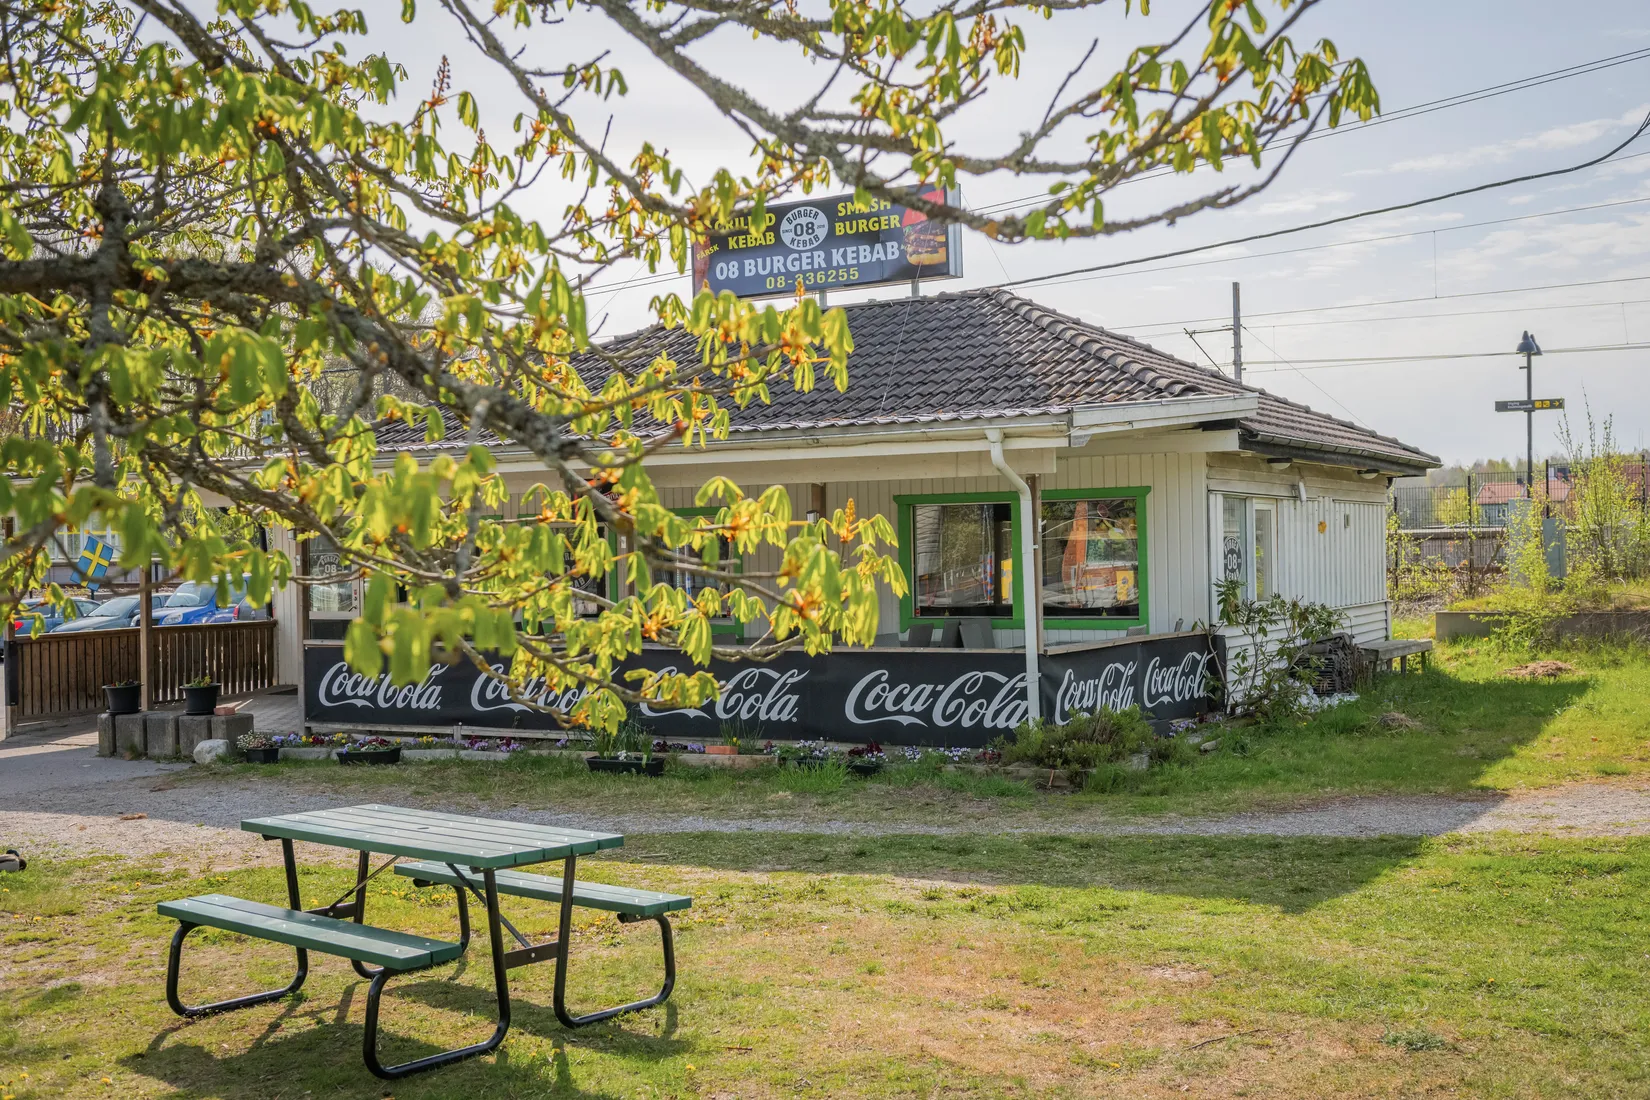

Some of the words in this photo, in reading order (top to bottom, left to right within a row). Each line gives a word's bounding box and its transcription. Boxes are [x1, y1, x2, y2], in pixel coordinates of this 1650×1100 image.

[837, 198, 891, 217] SMSH
[714, 213, 776, 231] GRILD
[786, 209, 819, 225] BURGER
[835, 215, 901, 236] BURGER
[794, 221, 815, 237] 08
[728, 232, 775, 250] KEBAB
[790, 234, 820, 248] KEBAB
[716, 261, 739, 280] 08
[744, 250, 827, 277] BURGER
[831, 241, 900, 268] KEBAB
[324, 564, 337, 573] 08
[1227, 553, 1238, 569] 08
[319, 661, 449, 710] Coca-Cola
[639, 666, 810, 722] C-Cola
[845, 669, 1031, 729] Coca-Cola
[1055, 660, 1138, 726] Coca-Cola
